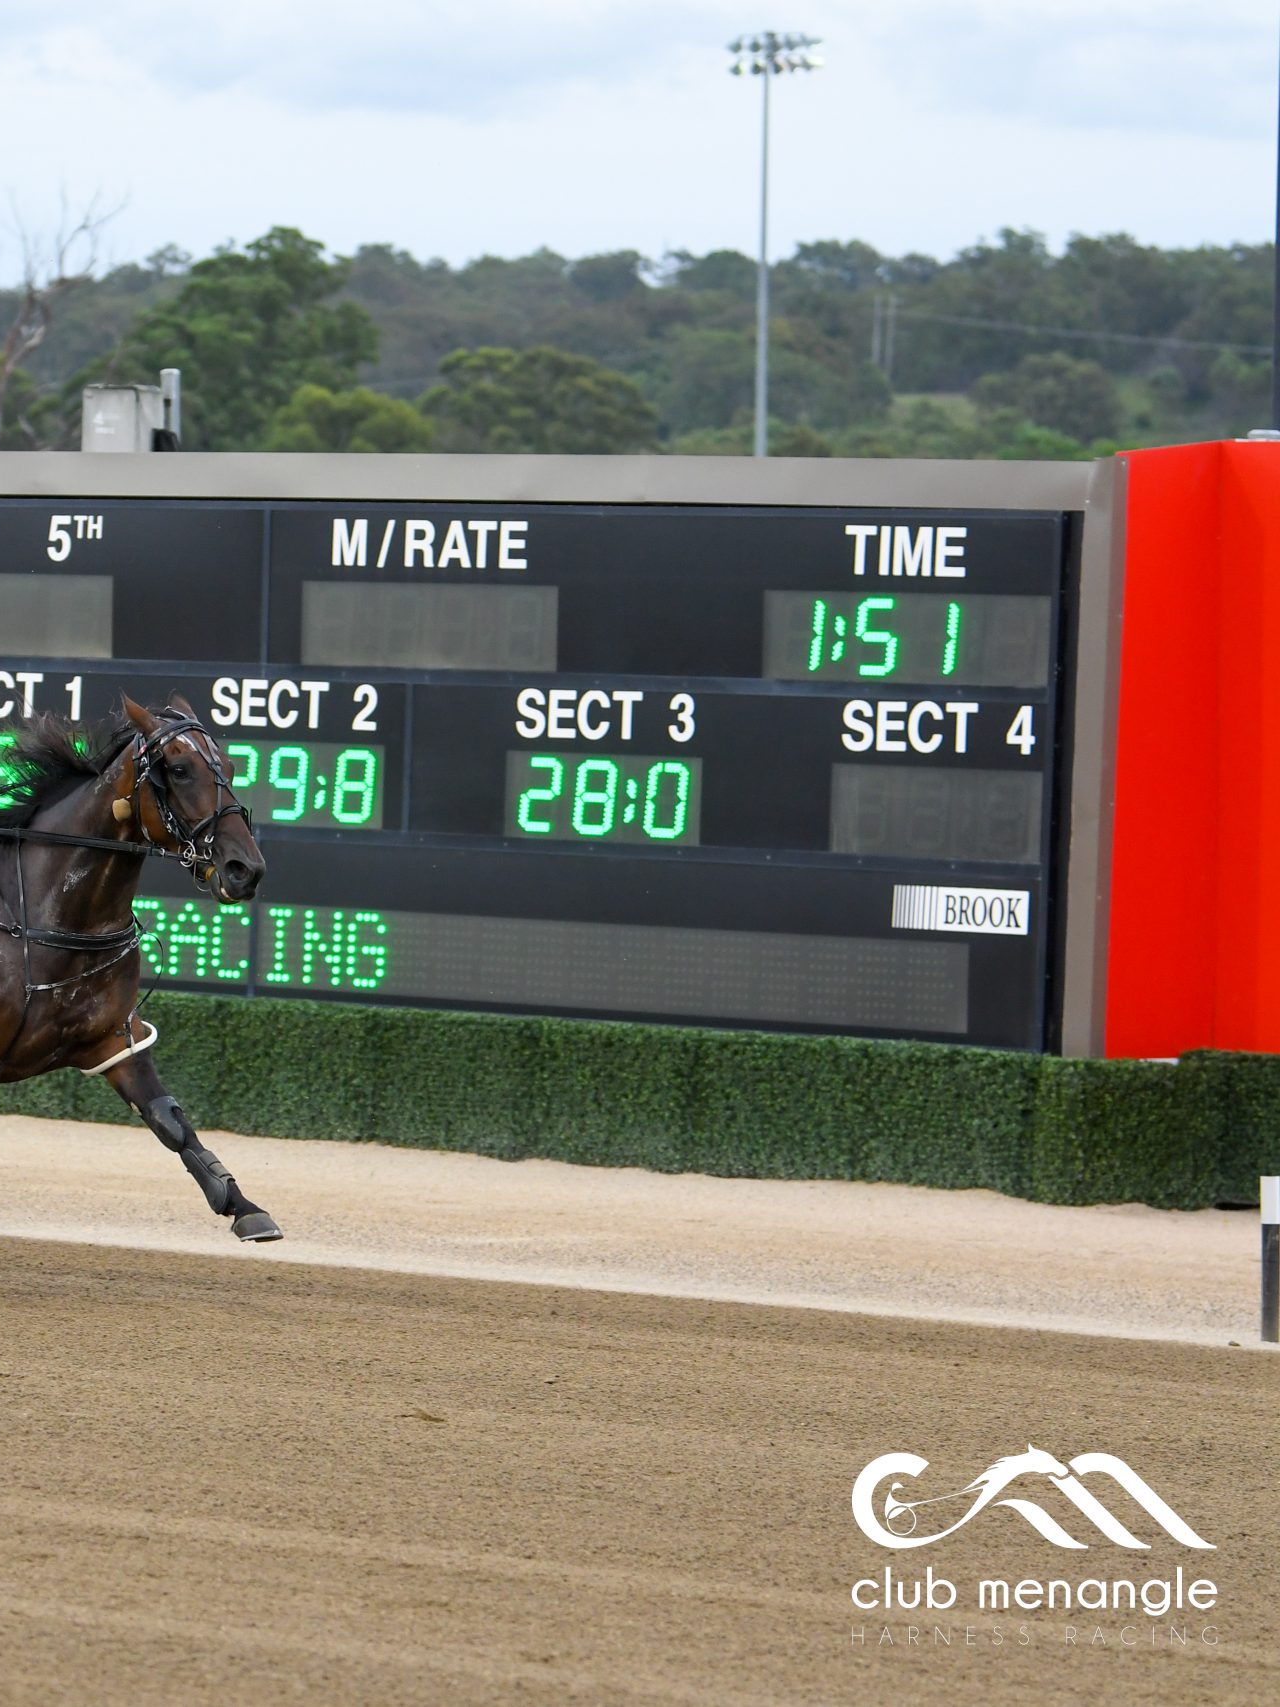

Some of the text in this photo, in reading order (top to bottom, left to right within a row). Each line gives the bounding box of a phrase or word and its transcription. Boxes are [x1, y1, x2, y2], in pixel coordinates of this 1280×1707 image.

[47, 515, 103, 562] 5TH
[845, 524, 967, 578] TIME
[65, 675, 83, 721] 1
[210, 677, 379, 731] SECT 2
[515, 688, 696, 742] SECT 3
[841, 699, 1036, 756] SECT 4
[516, 756, 690, 840] 28:0
[943, 894, 1023, 929] BROOK
